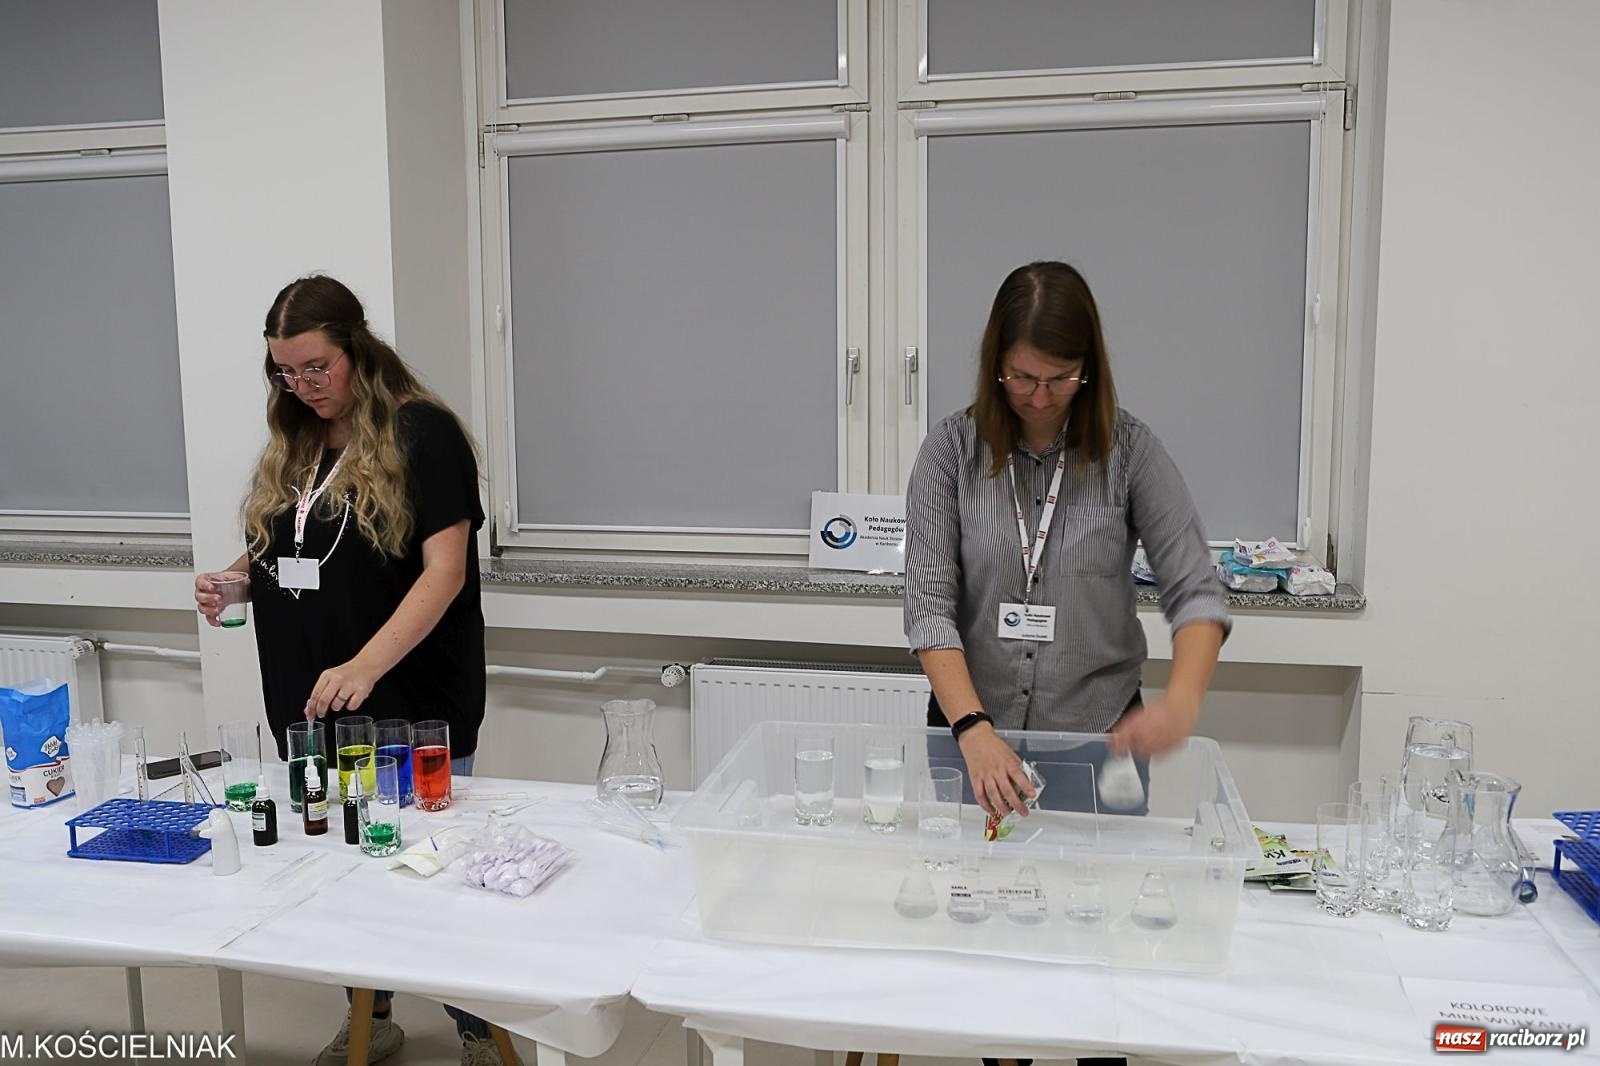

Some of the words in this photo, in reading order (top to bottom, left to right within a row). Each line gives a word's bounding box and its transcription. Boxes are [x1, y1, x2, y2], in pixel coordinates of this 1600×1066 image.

[868, 525, 905, 533] Pedagogów
[1449, 1001, 1549, 1017] KOLOROWE
[1439, 1011, 1481, 1022] MINI
